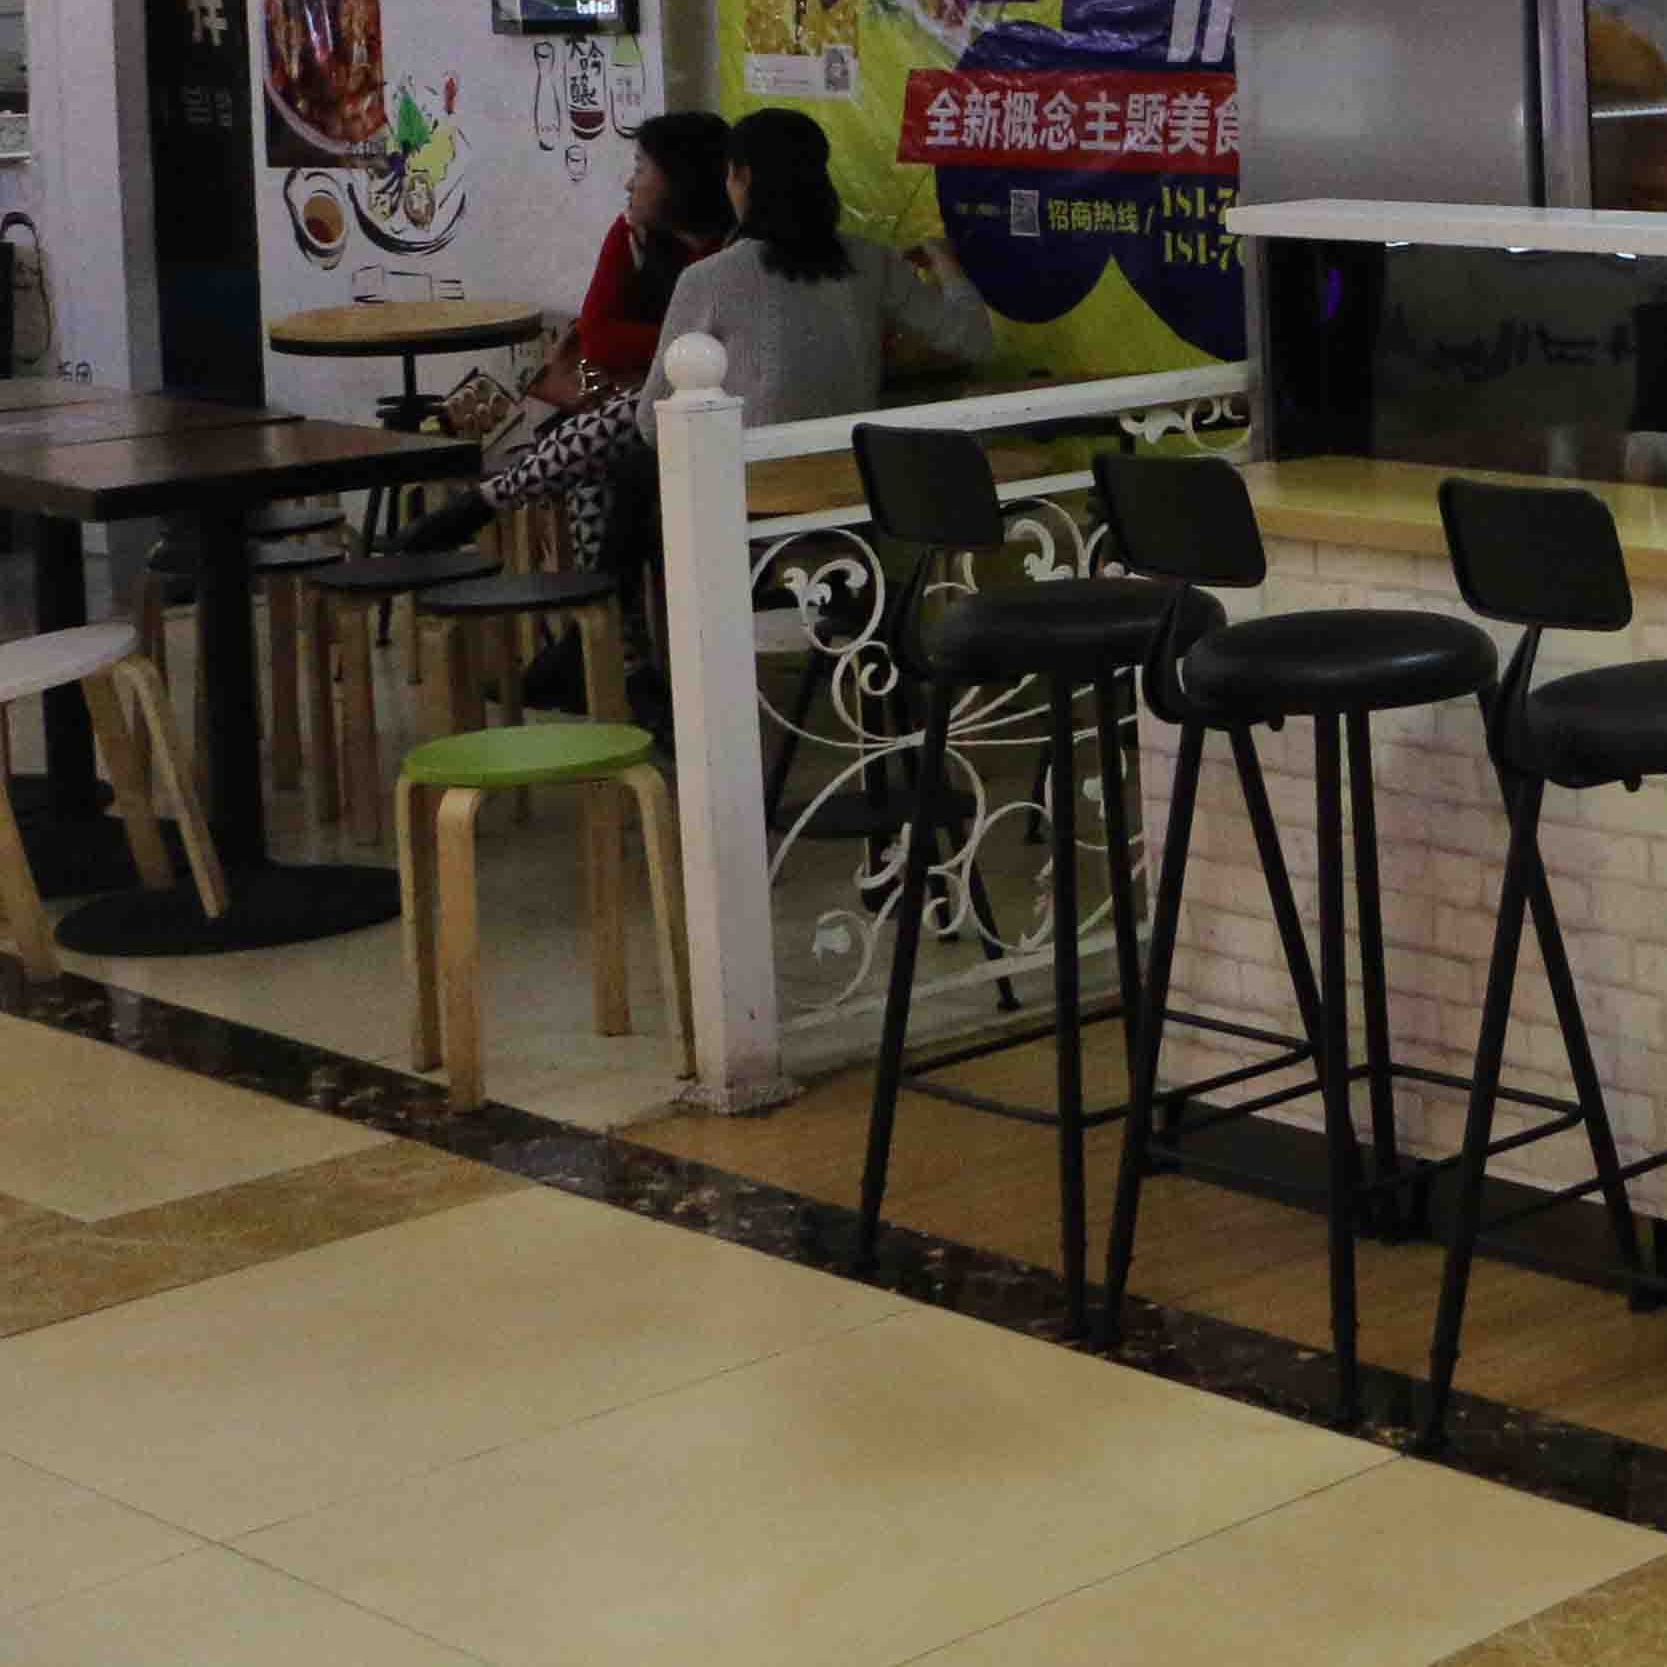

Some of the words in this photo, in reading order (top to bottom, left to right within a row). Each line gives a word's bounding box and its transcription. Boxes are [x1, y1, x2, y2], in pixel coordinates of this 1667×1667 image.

[926, 87, 1240, 157] 全新概念主题美食
[1048, 197, 1140, 233] 招商热线
[1162, 184, 1240, 228] 181-7
